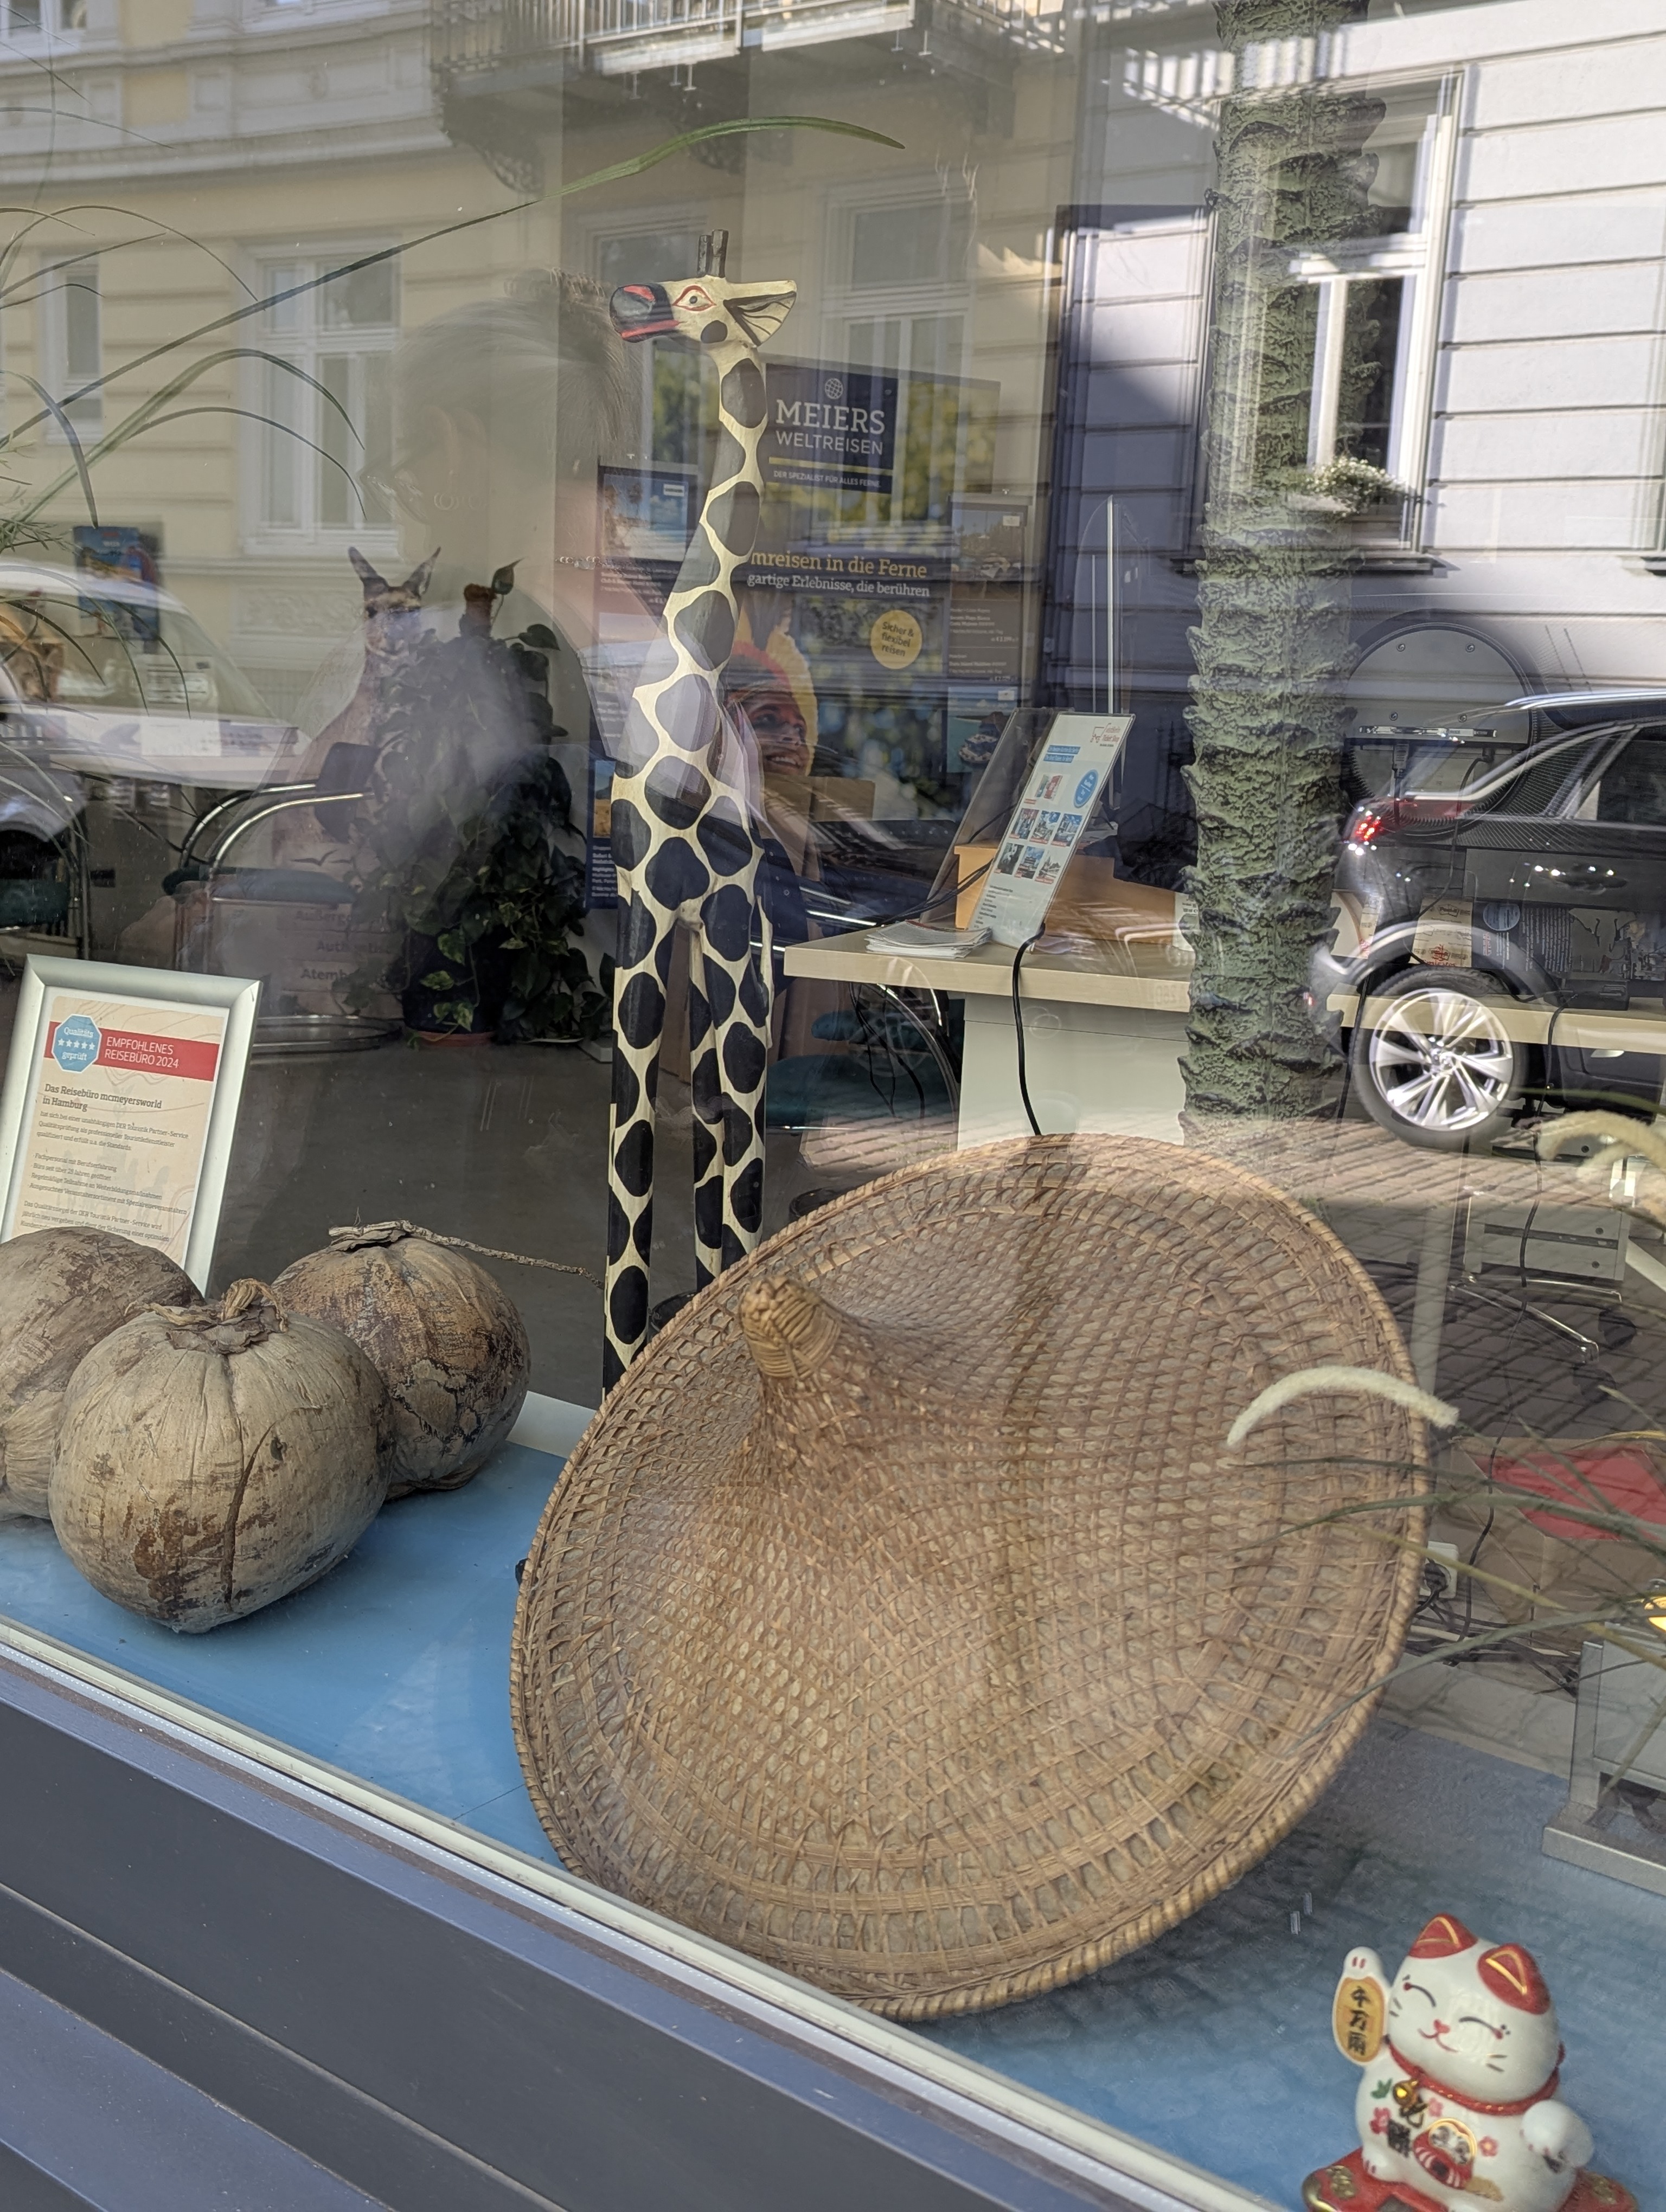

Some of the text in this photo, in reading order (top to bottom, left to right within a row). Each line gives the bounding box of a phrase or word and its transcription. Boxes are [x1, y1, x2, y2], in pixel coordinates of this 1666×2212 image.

[776, 399, 885, 434] MEIERS
[776, 430, 883, 455] WELTREISEN
[789, 471, 823, 481] SPEZIALIST
[825, 475, 838, 483] FÜR
[841, 477, 858, 485] ALLES
[751, 550, 927, 578] mreisen in die Ferne
[747, 573, 930, 597] gartige Erlebnisse, die berühren
[882, 621, 914, 637] Sicher &
[882, 632, 911, 647] flexibel
[882, 645, 906, 657] reisen
[63, 1027, 93, 1038] Qualitäts
[106, 1037, 174, 1055] EMPFOHLENES
[62, 1052, 87, 1061] geprüft
[105, 1049, 179, 1069] REISEBÜRO 2024
[43, 1096, 88, 1112] in Hamburg
[44, 1084, 162, 1109] Das Reisebüro mcmeyersworld
